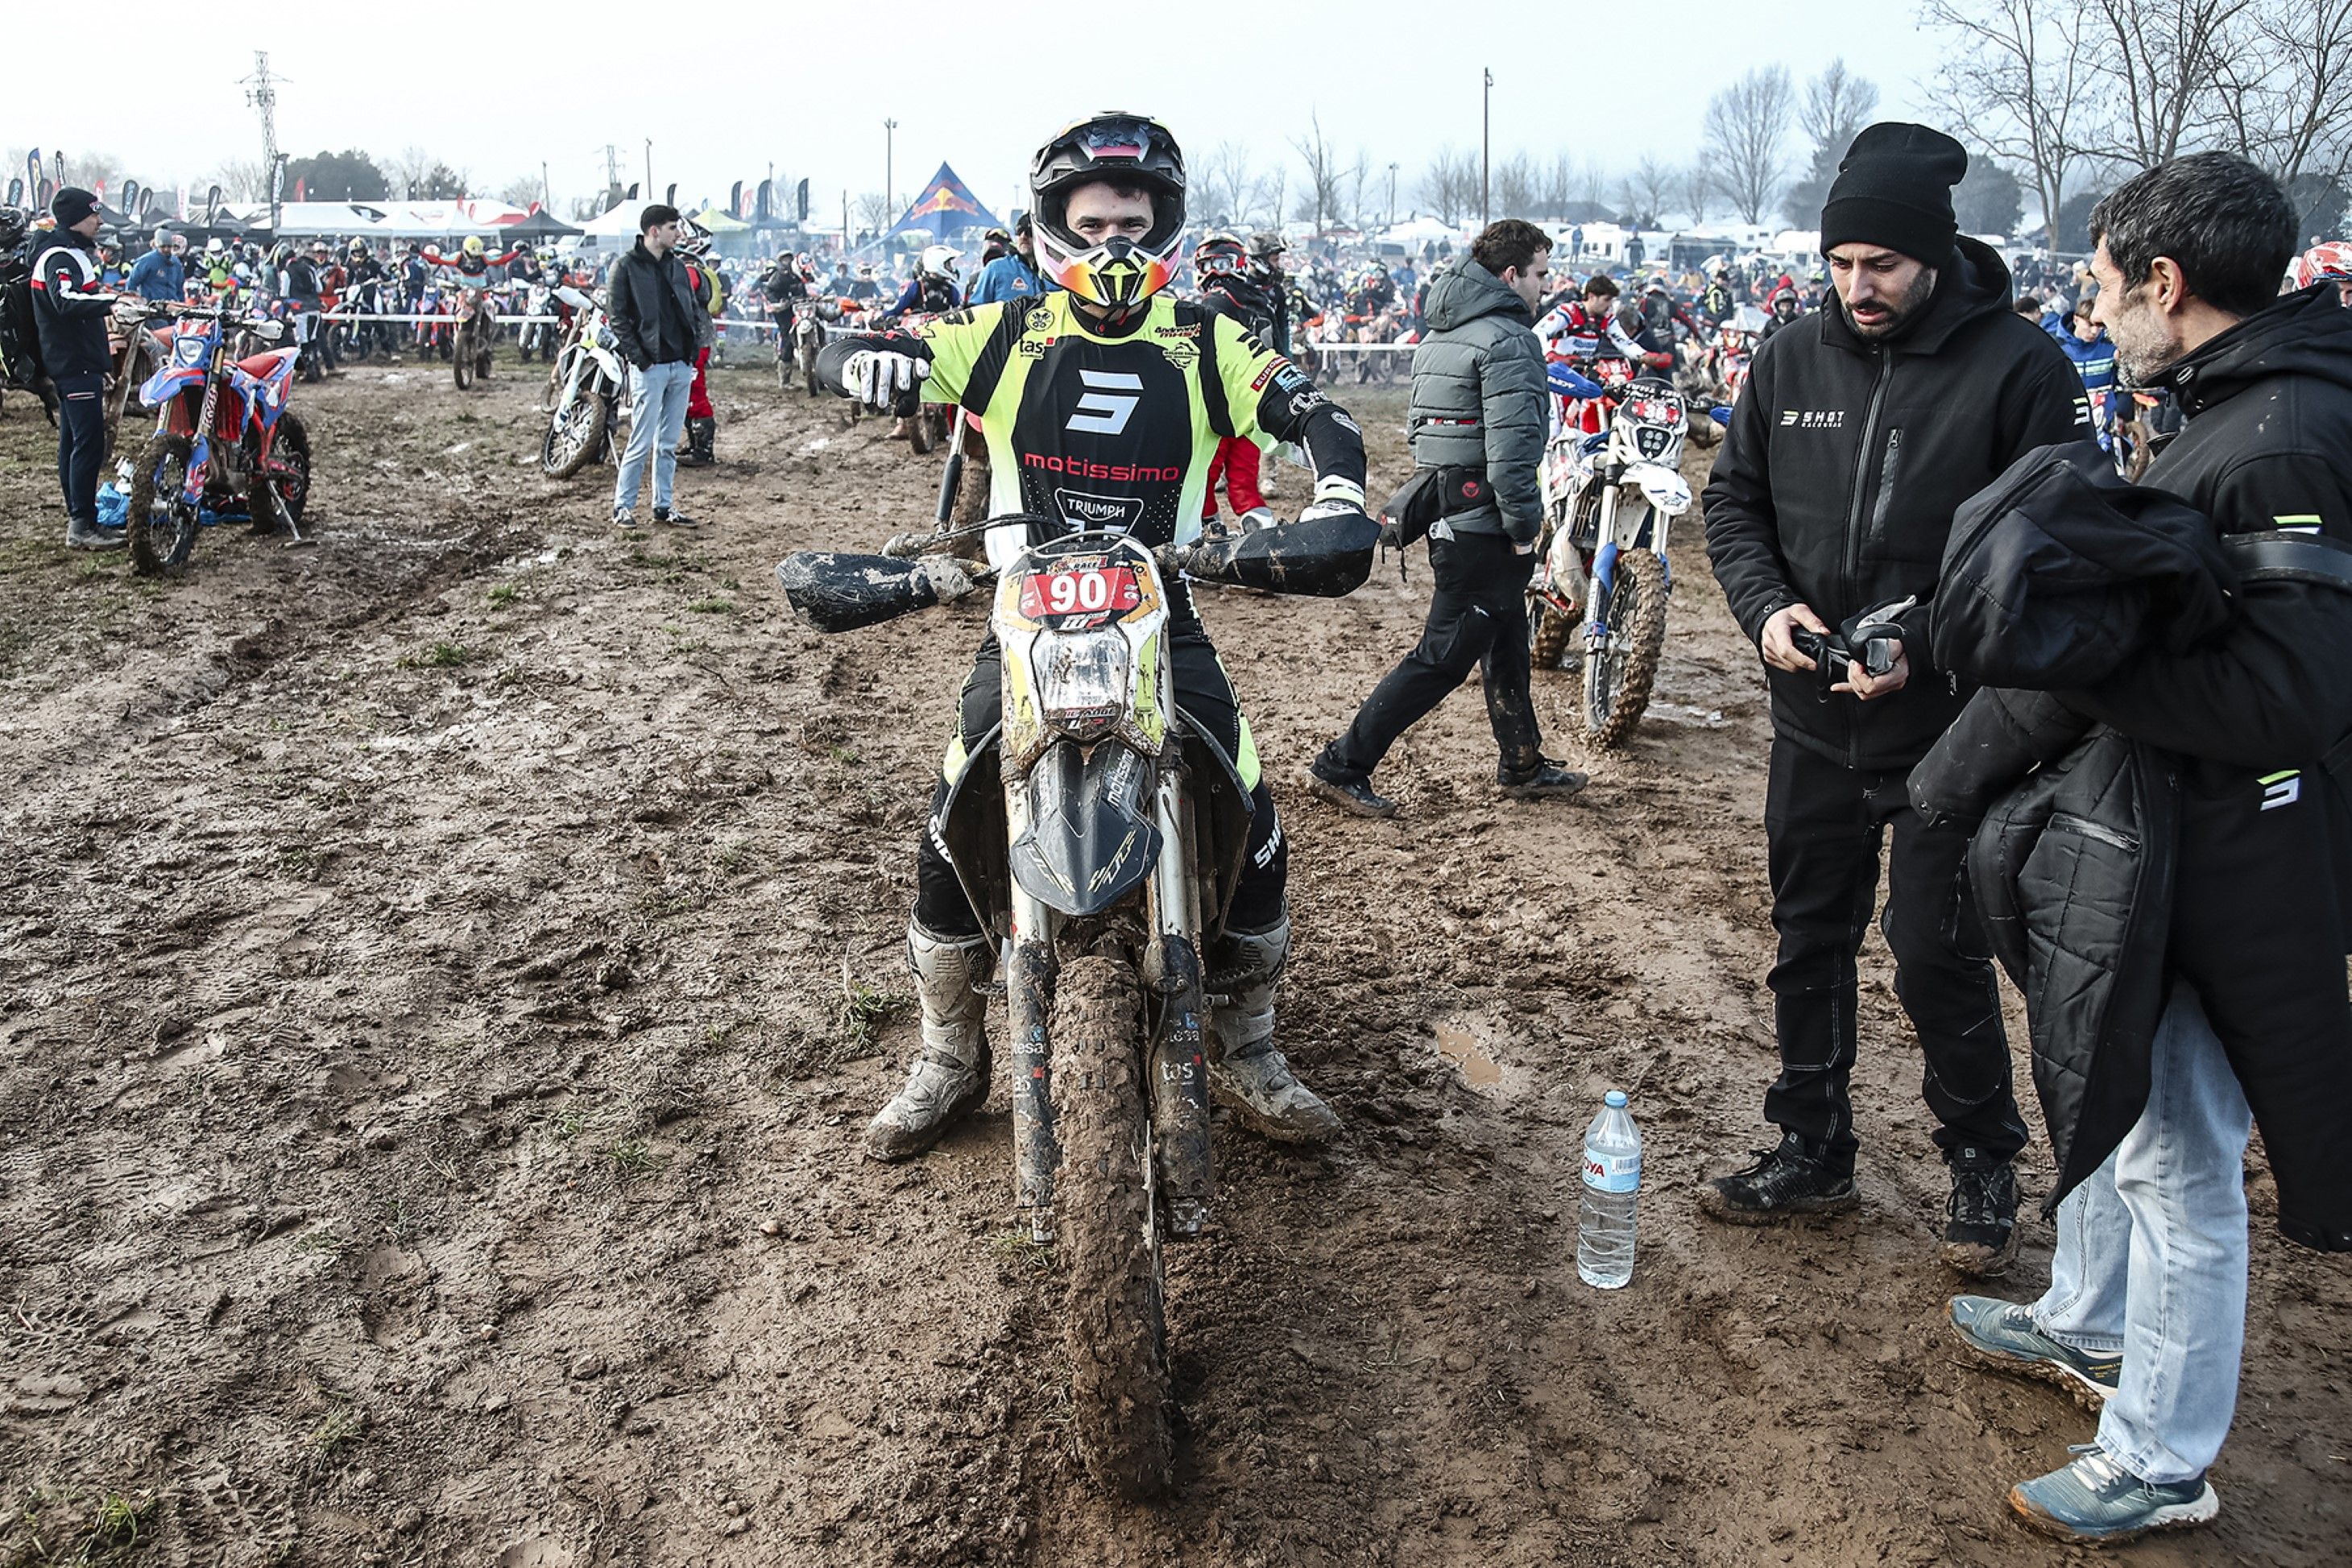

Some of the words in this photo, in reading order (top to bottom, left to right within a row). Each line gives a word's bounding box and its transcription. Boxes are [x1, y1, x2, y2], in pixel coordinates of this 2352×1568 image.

[1020, 339, 1044, 353] tas
[1803, 411, 1845, 422] SHOT
[1025, 453, 1179, 482] motissimo
[1067, 499, 1125, 518] TRIUMPH
[1050, 573, 1108, 612] 90
[1107, 747, 1135, 809] motissimo
